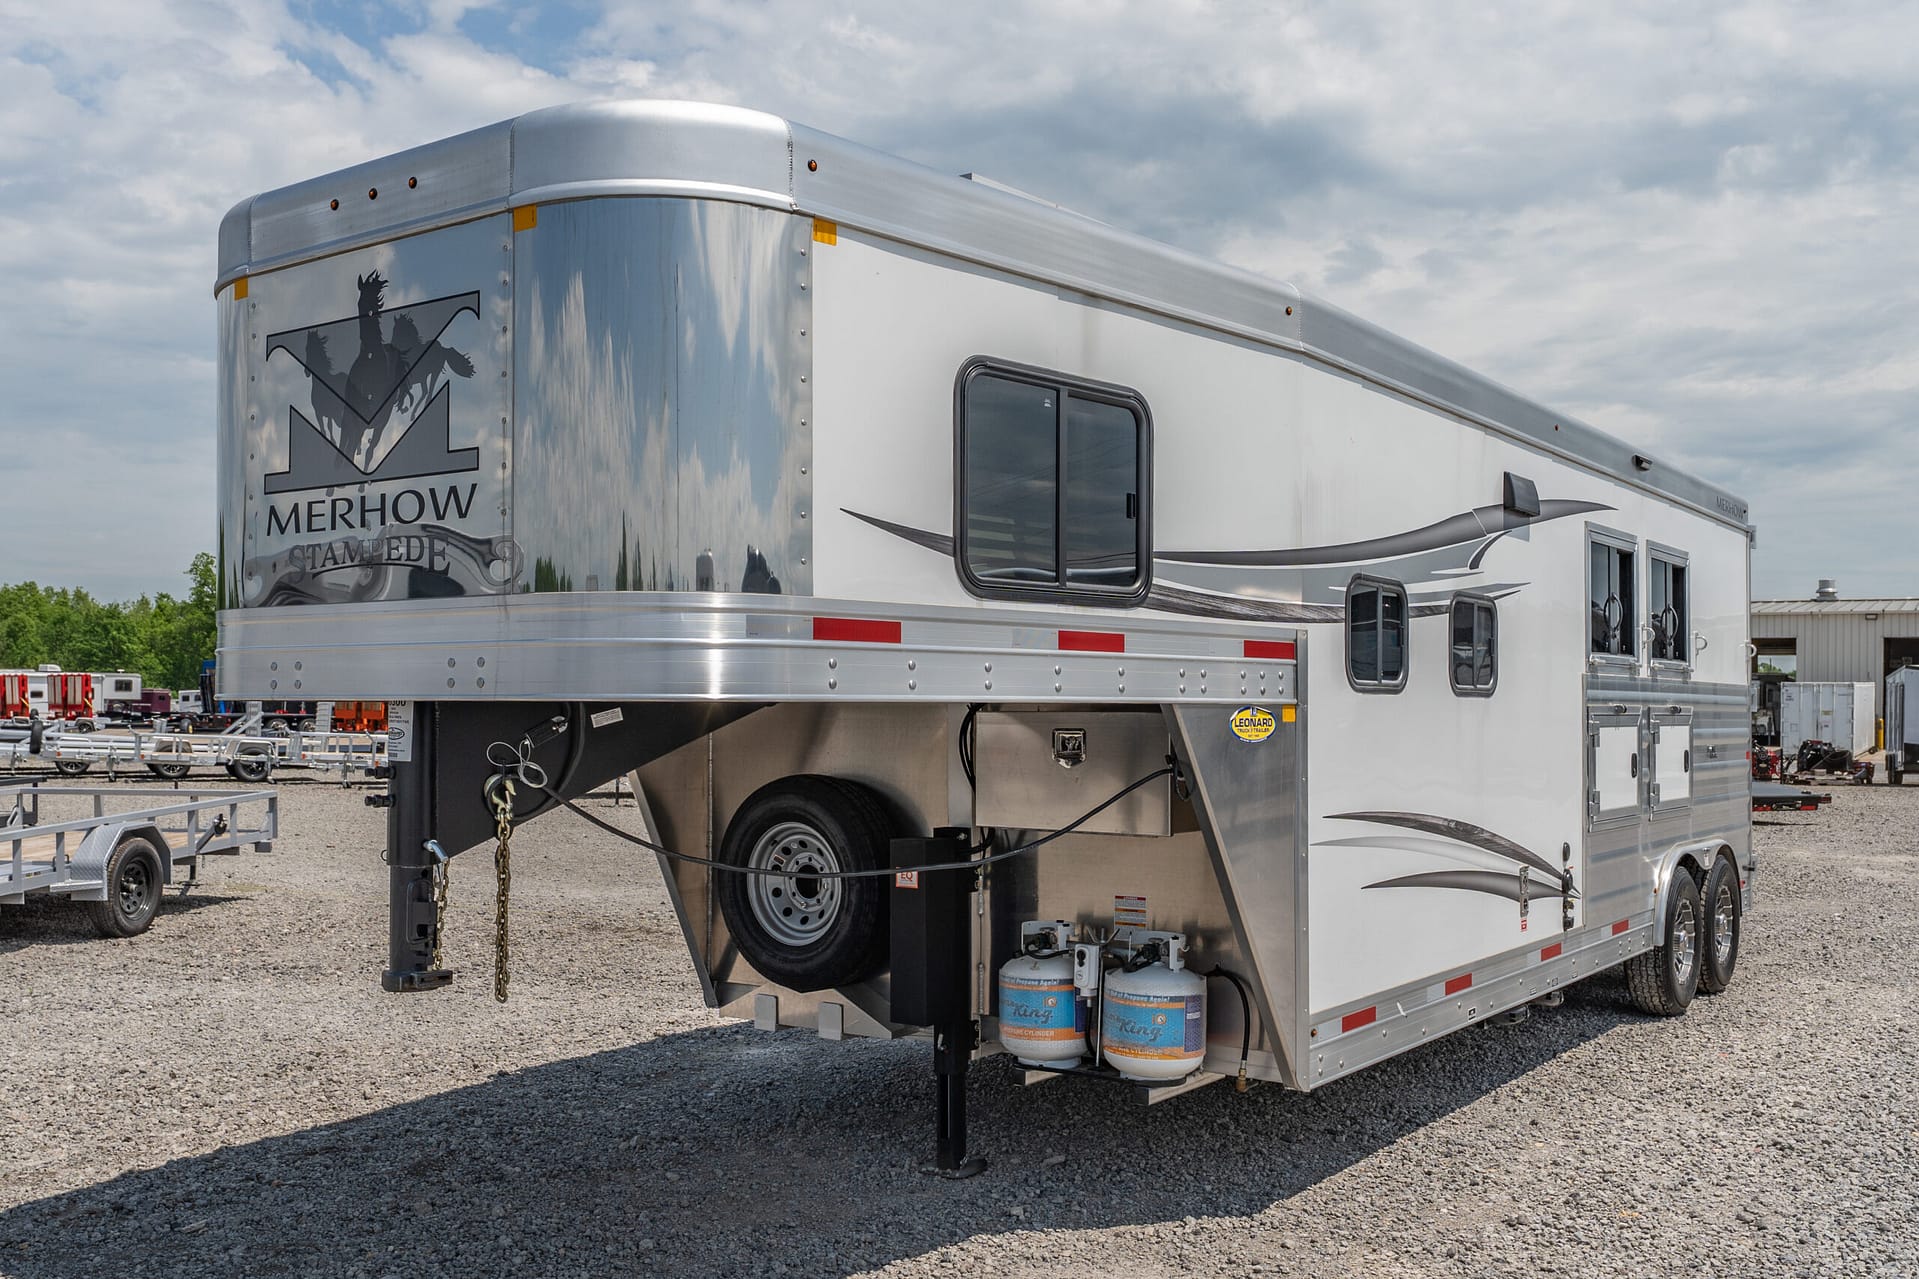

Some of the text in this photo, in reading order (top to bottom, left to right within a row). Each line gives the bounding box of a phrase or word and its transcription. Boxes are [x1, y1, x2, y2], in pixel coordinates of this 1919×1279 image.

[266, 482, 479, 537] MERHOW
[289, 535, 451, 583] STAMPEDE
[1234, 718, 1273, 727] LEONARD
[1013, 1004, 1053, 1024] King
[1119, 1018, 1162, 1042] King
